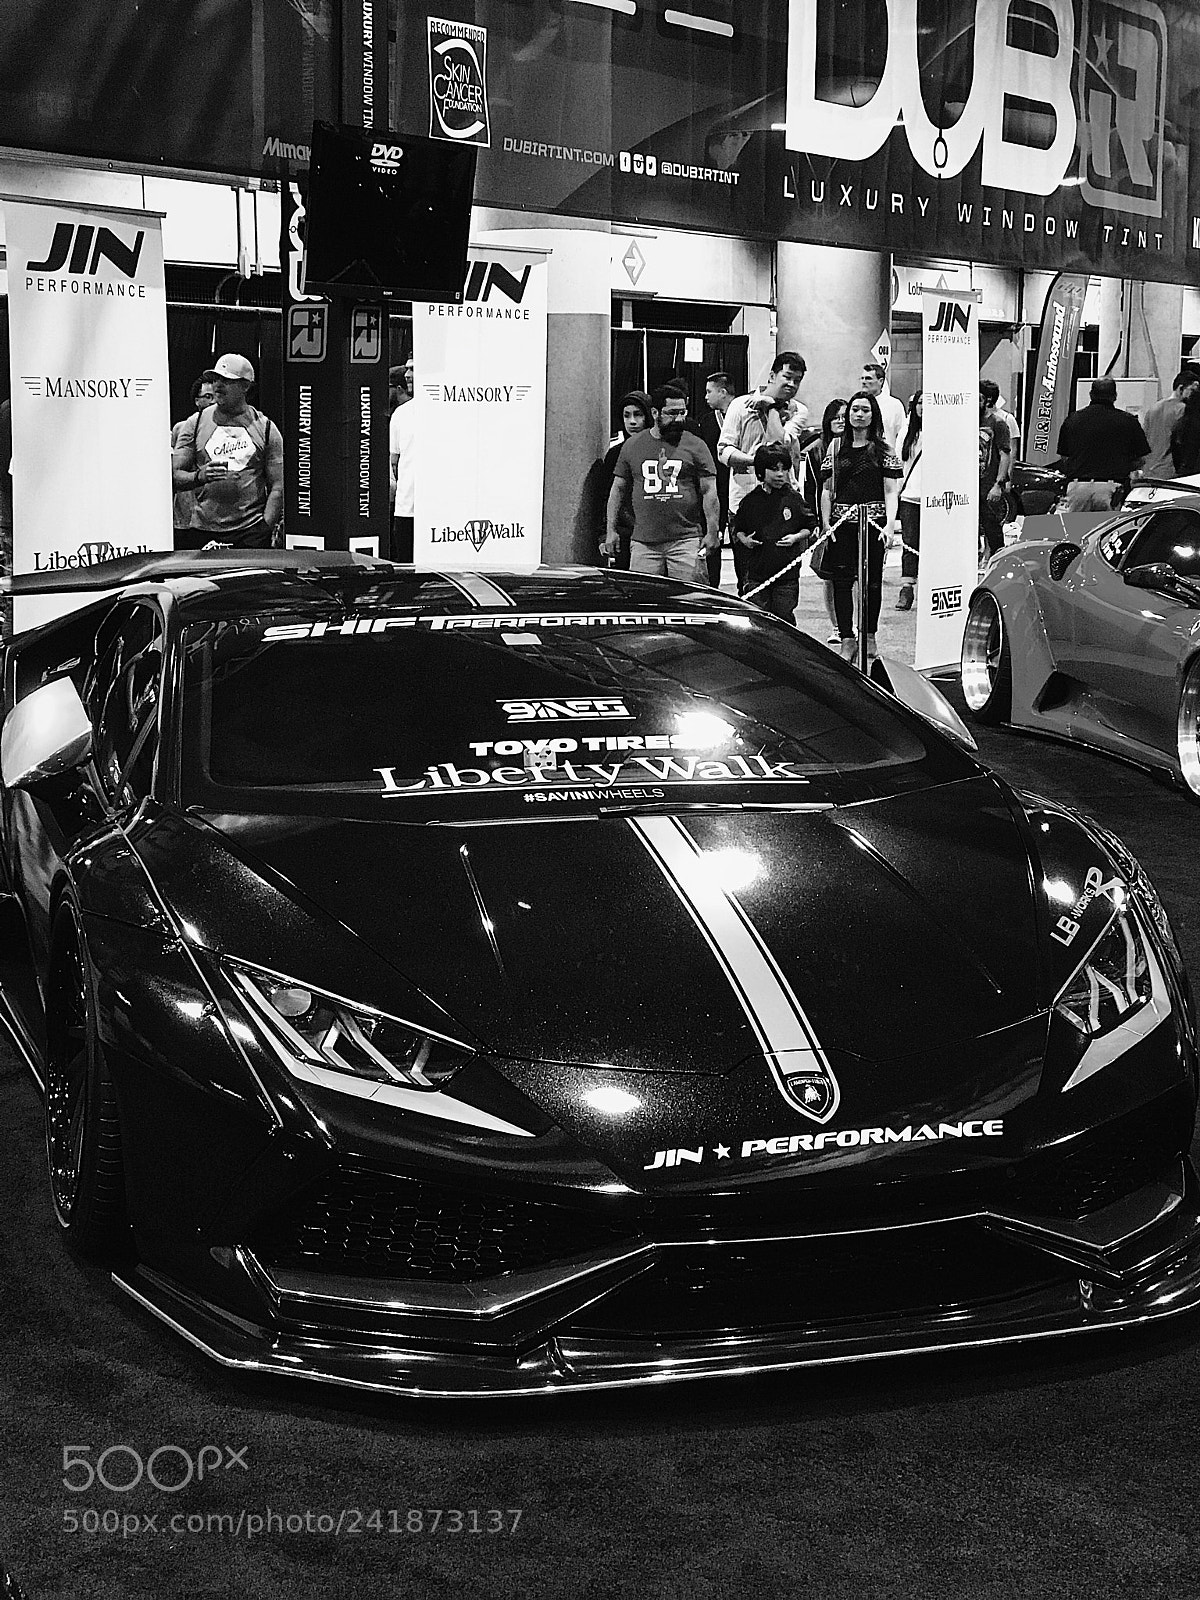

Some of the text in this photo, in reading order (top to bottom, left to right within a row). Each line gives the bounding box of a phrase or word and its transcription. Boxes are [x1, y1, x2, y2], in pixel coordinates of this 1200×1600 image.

[430, 20, 485, 43] RECOMMENDED
[363, 0, 374, 129] UXURY WINDOW TIN
[444, 55, 471, 84] SKIN
[434, 74, 483, 105] CANCER
[785, 0, 1076, 197] DUB
[443, 99, 483, 118] FOUNDATION
[371, 143, 403, 160] DVD
[503, 137, 741, 185] DUBIRTINT.COM @DUBIRTINT
[372, 166, 397, 175] VIDEO
[784, 176, 929, 217] LUXURY
[957, 203, 1078, 239] WINDOW
[1103, 225, 1163, 251] TINT
[26, 222, 145, 279] JIN
[25, 277, 146, 298] PERFORMANCE
[465, 260, 532, 304] IN
[428, 304, 530, 320] PERFORMANCE
[929, 302, 972, 333] JIN
[927, 334, 971, 345] PERFORMANCE
[1042, 300, 1066, 392] Autosound
[45, 377, 132, 399] MANSORY
[443, 385, 514, 403] MANSORY
[298, 385, 312, 517] LUXURY WINDOW TINT
[359, 386, 371, 518] LUXURY WINDOW TINT
[641, 459, 683, 494] 87
[489, 522, 525, 540] Walk
[446, 614, 720, 630] PERFORMANCE
[469, 738, 578, 757] TOYO
[373, 754, 806, 793] Liberty Walk
[523, 788, 665, 803] #SAVINIWHEELS
[1050, 915, 1080, 947] LB
[643, 1119, 1004, 1171] JIN PERFORMANCE
